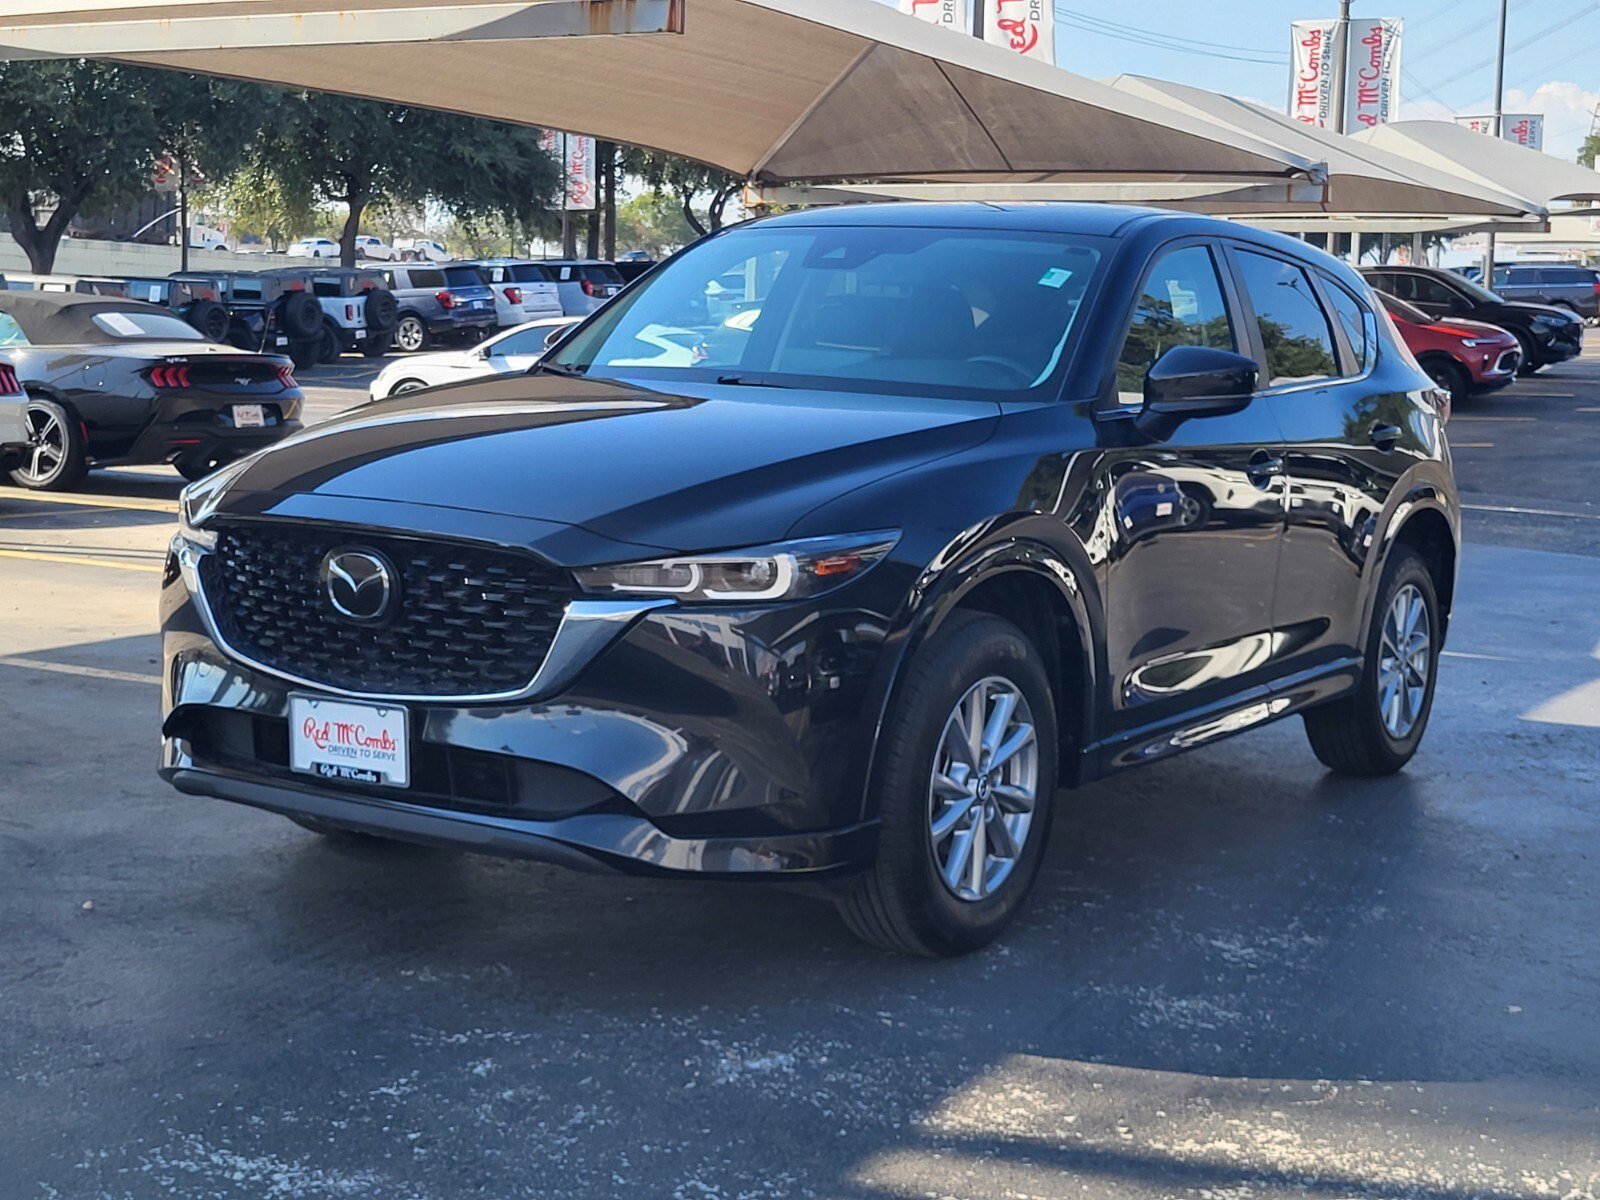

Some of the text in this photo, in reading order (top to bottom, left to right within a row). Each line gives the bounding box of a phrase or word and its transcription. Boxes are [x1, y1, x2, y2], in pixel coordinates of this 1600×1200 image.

[1298, 29, 1321, 110] McCombs
[1321, 63, 1329, 77] TO
[1357, 26, 1383, 111] McCombs
[1320, 80, 1329, 118] DRIVEN
[1380, 77, 1390, 117] DRIVEN
[303, 717, 396, 751] Red McCombs
[320, 764, 338, 778] Red
[328, 745, 396, 761] DRIVEN TO SERVE
